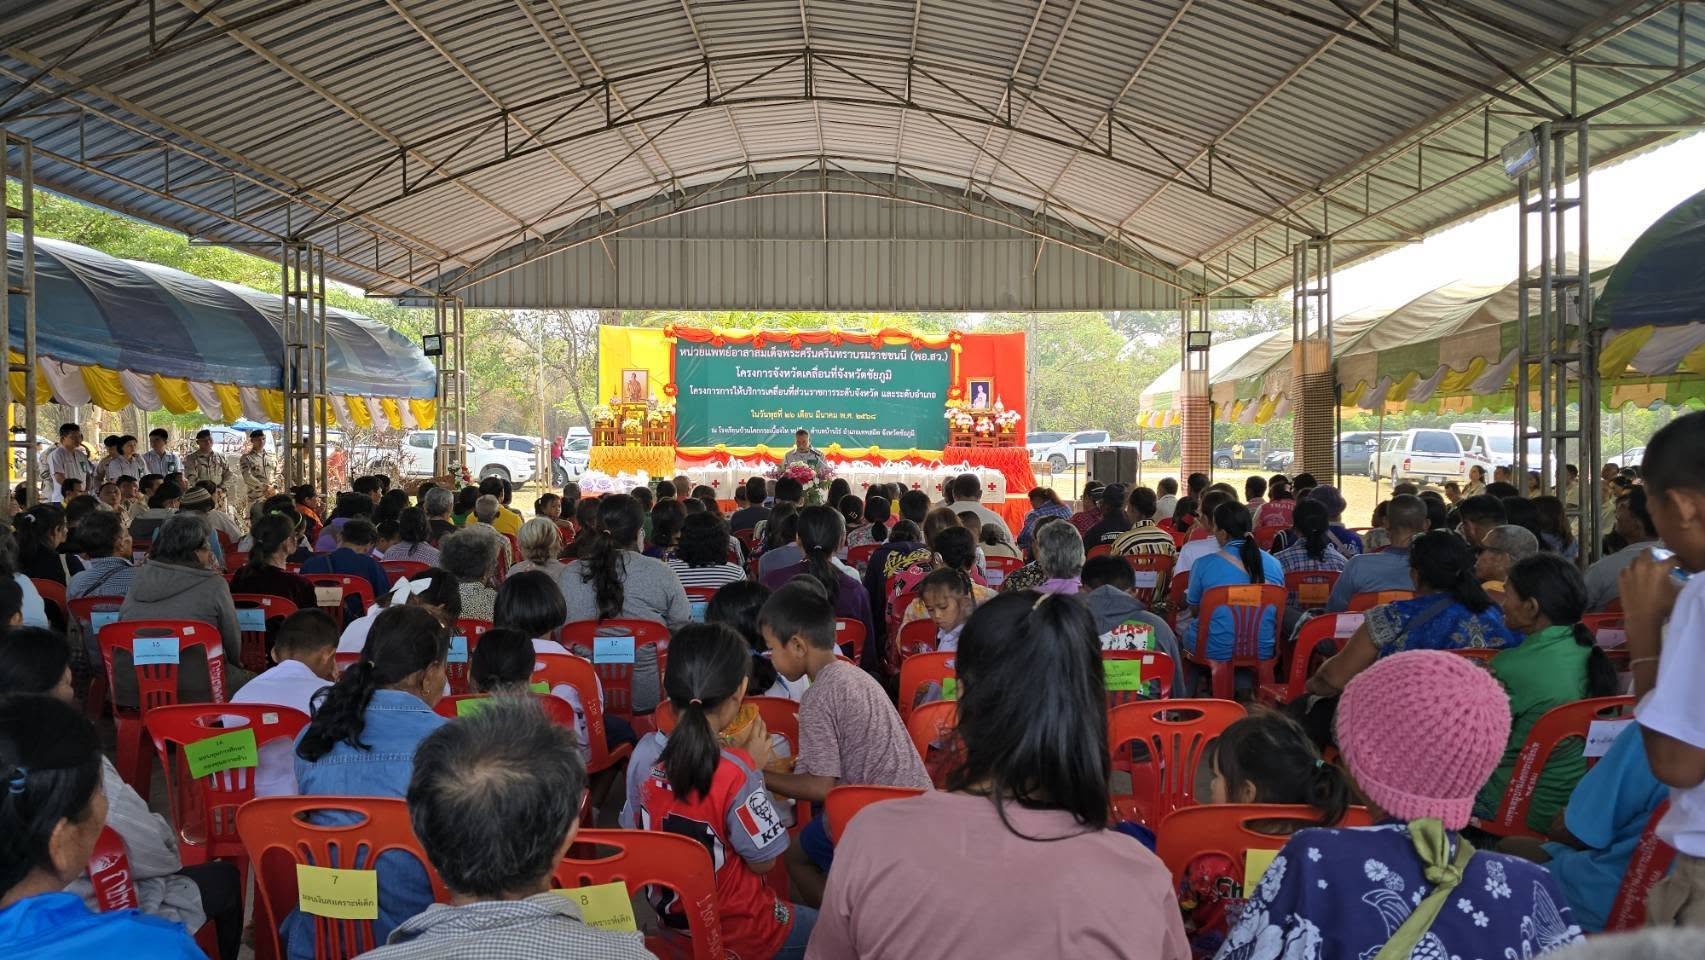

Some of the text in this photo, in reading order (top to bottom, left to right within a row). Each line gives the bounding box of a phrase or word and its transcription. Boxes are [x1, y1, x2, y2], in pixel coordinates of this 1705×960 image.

[910, 350, 948, 362] (พอ.สว.)
[735, 365, 892, 384] โครงการจังหวัดเคลื่อนที่จังหวัดชัยภูมิ
[881, 389, 937, 399] และระดับอำเภอ
[797, 409, 814, 419] เดือน
[815, 410, 838, 419] มีนาคม
[331, 875, 339, 885] 7
[580, 894, 589, 906] 8
